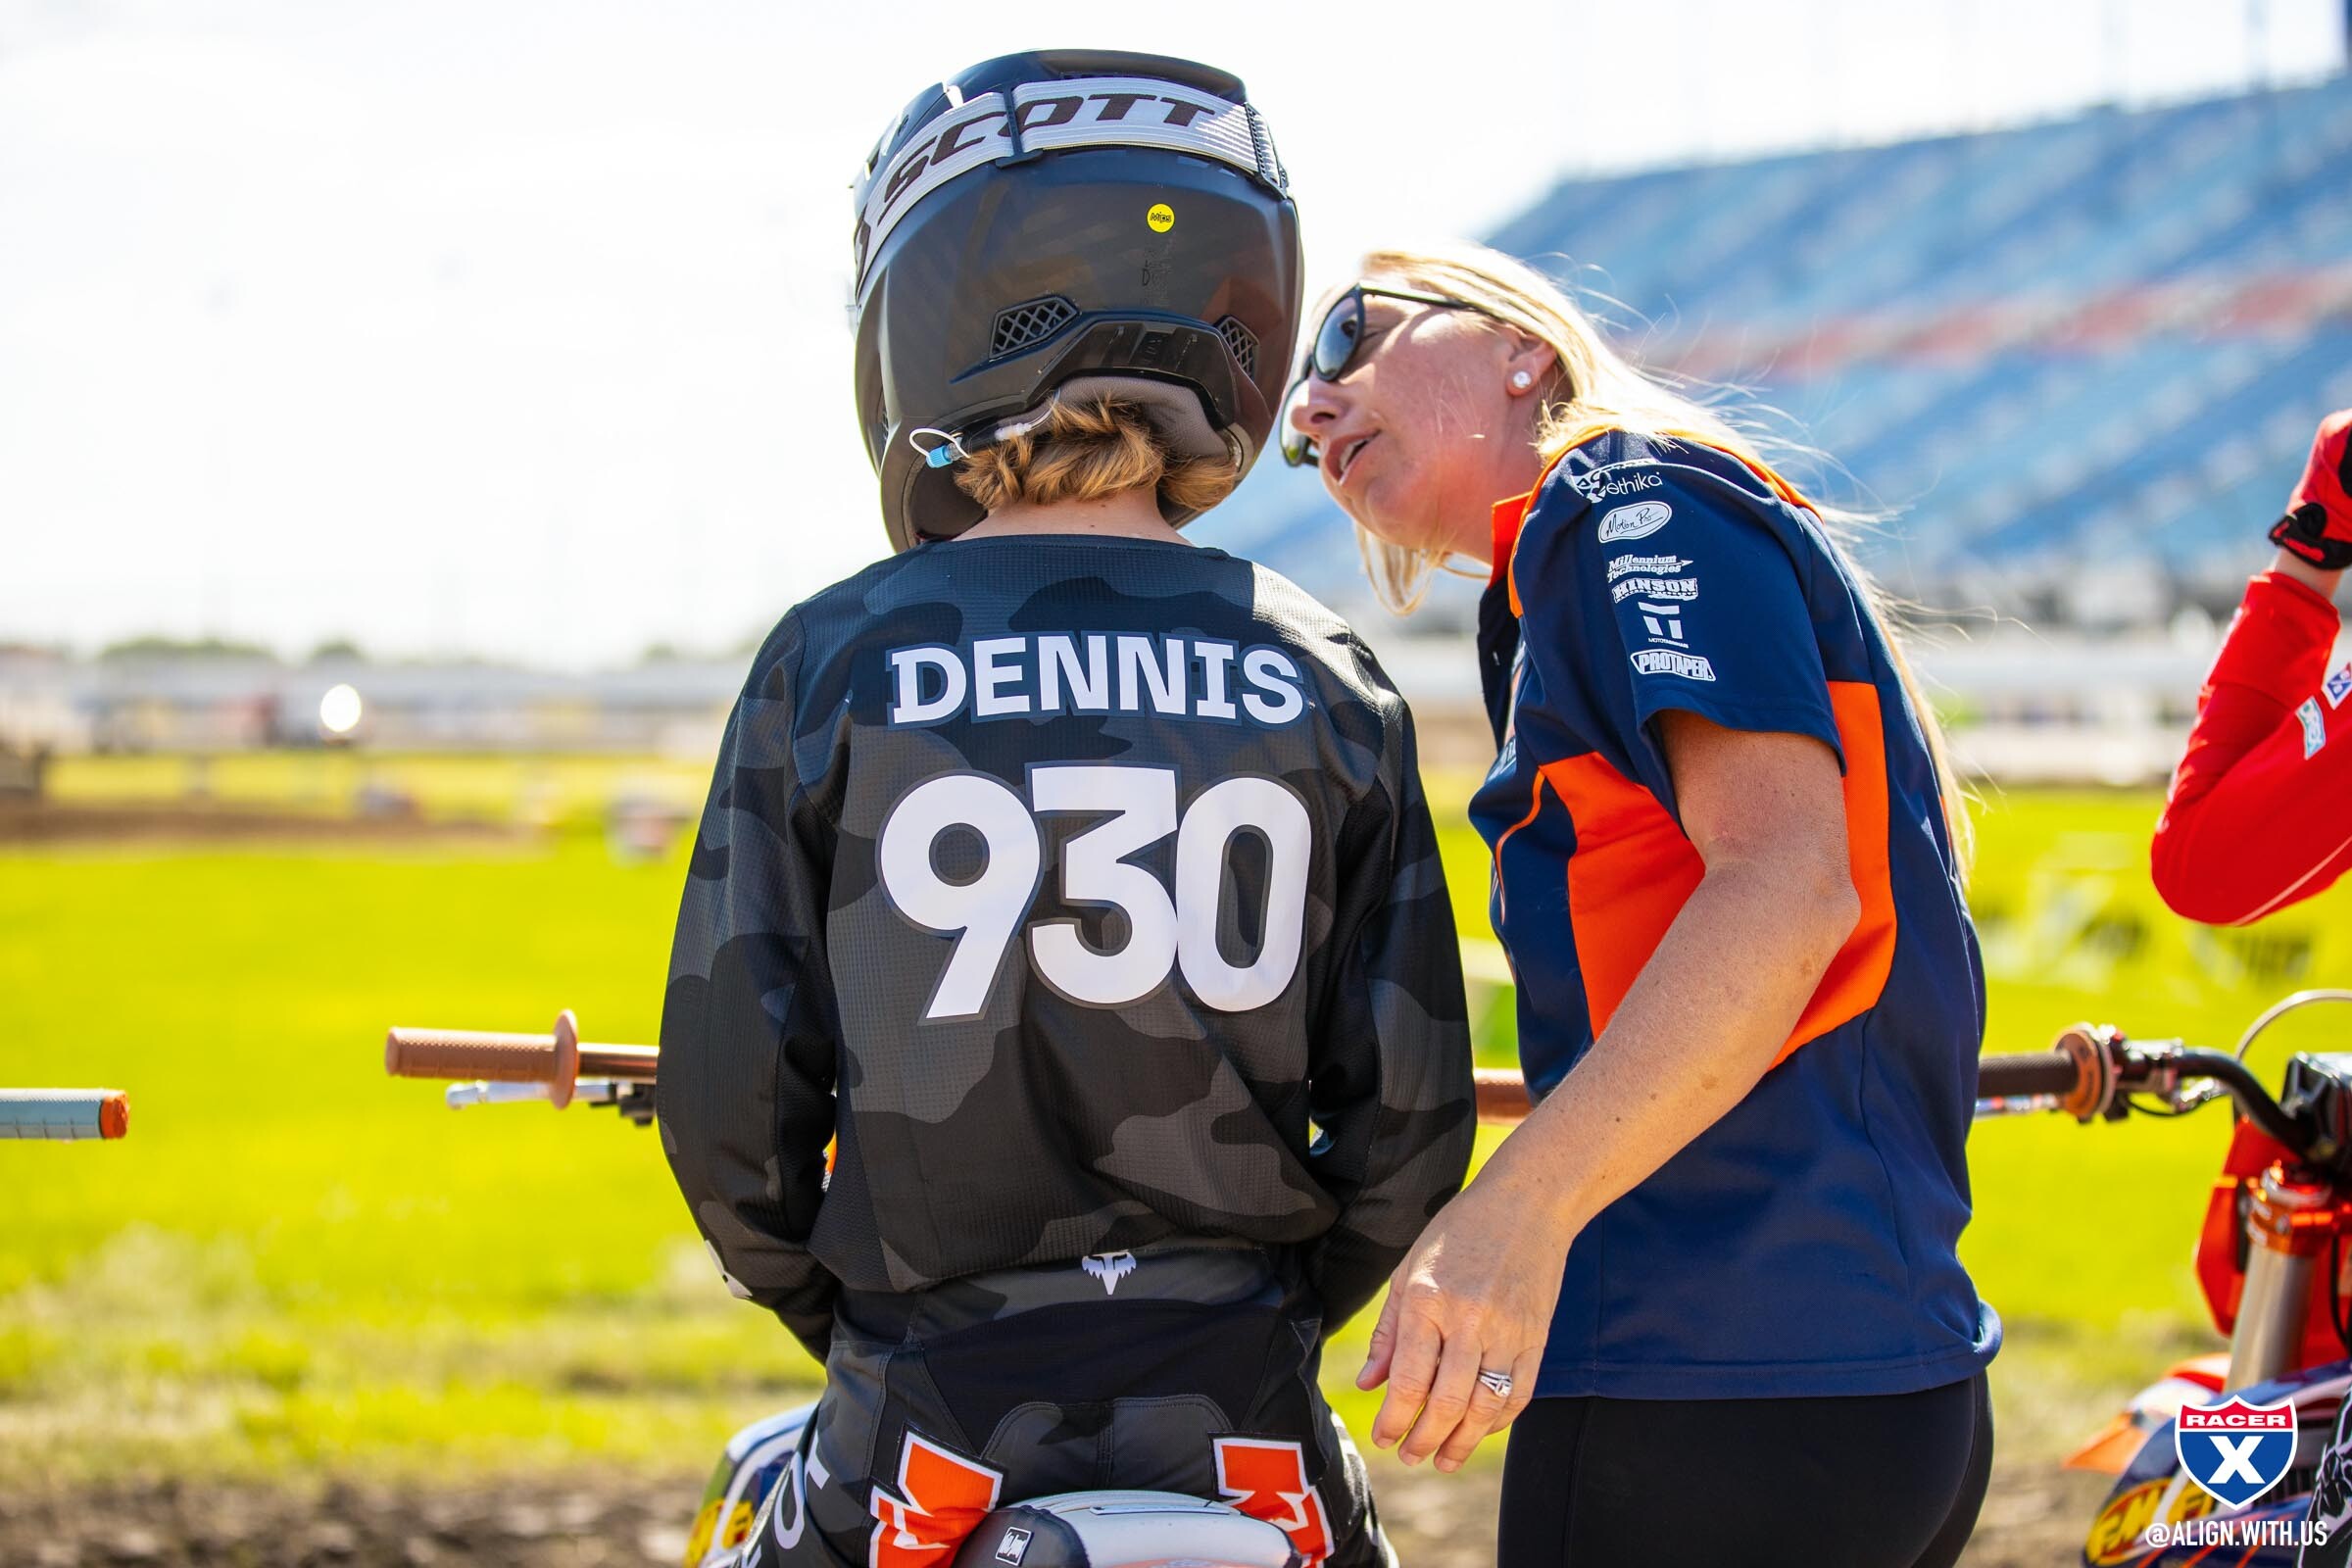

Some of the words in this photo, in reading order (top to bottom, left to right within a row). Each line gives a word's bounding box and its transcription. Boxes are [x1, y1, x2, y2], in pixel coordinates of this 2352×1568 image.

[877, 93, 1215, 227] SCOTT
[1150, 211, 1172, 223] Mips
[1606, 471, 1664, 495] ethika
[1605, 513, 1639, 537] Motion
[1636, 507, 1661, 524] Pro
[1607, 564, 1682, 583] Technologies
[1608, 554, 1677, 572] Millennium
[1614, 578, 1697, 600] HINSON
[1638, 652, 1710, 679] PROTAPER
[891, 635, 1304, 724] DENNIS
[880, 765, 1312, 1019] 930
